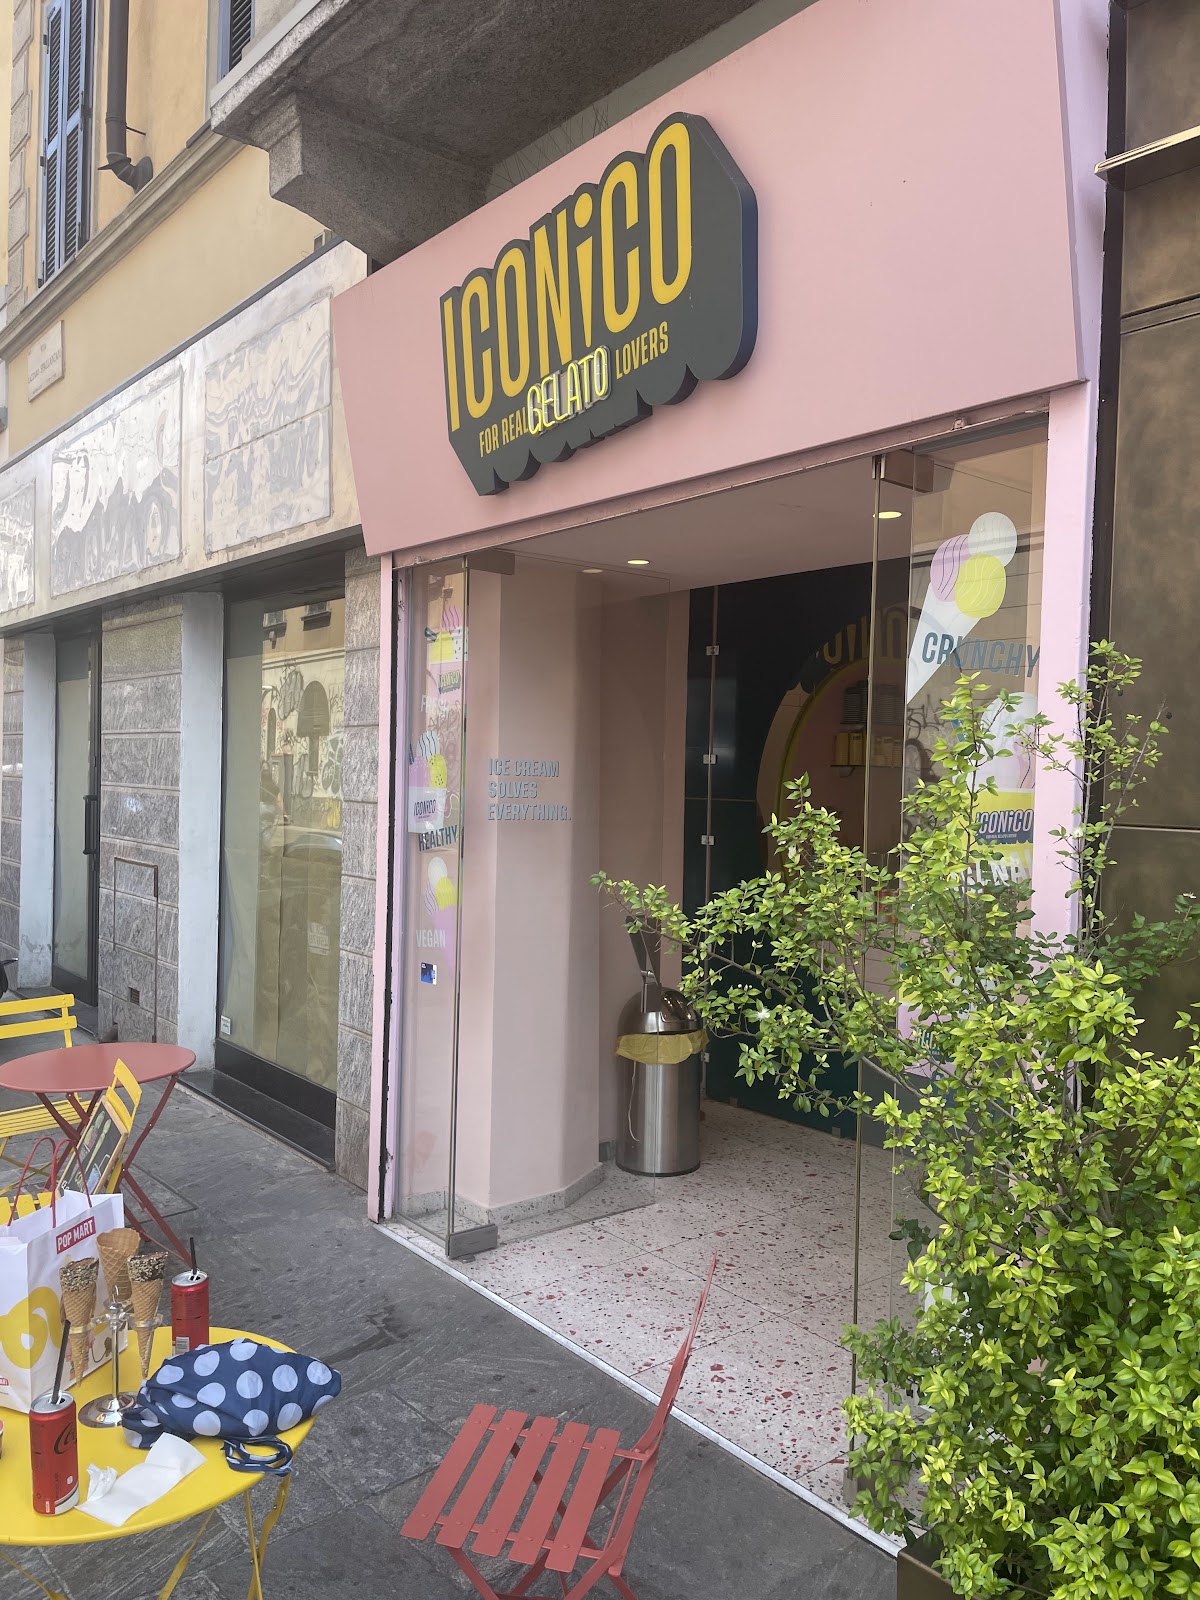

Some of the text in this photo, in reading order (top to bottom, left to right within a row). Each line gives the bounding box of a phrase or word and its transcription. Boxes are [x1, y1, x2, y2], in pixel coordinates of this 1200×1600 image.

[443, 122, 693, 433] ICONiCO
[479, 321, 670, 458] FOR REAL GELATO LOVERS
[922, 631, 1040, 678] CRUNCHY
[488, 759, 560, 777] ICE CREAM
[488, 781, 538, 799] SOLVES
[487, 803, 572, 821] EVERYTHING.
[418, 825, 458, 852] HEALTHY
[415, 929, 446, 949] VEGAN
[57, 1219, 94, 1251] POP MART
